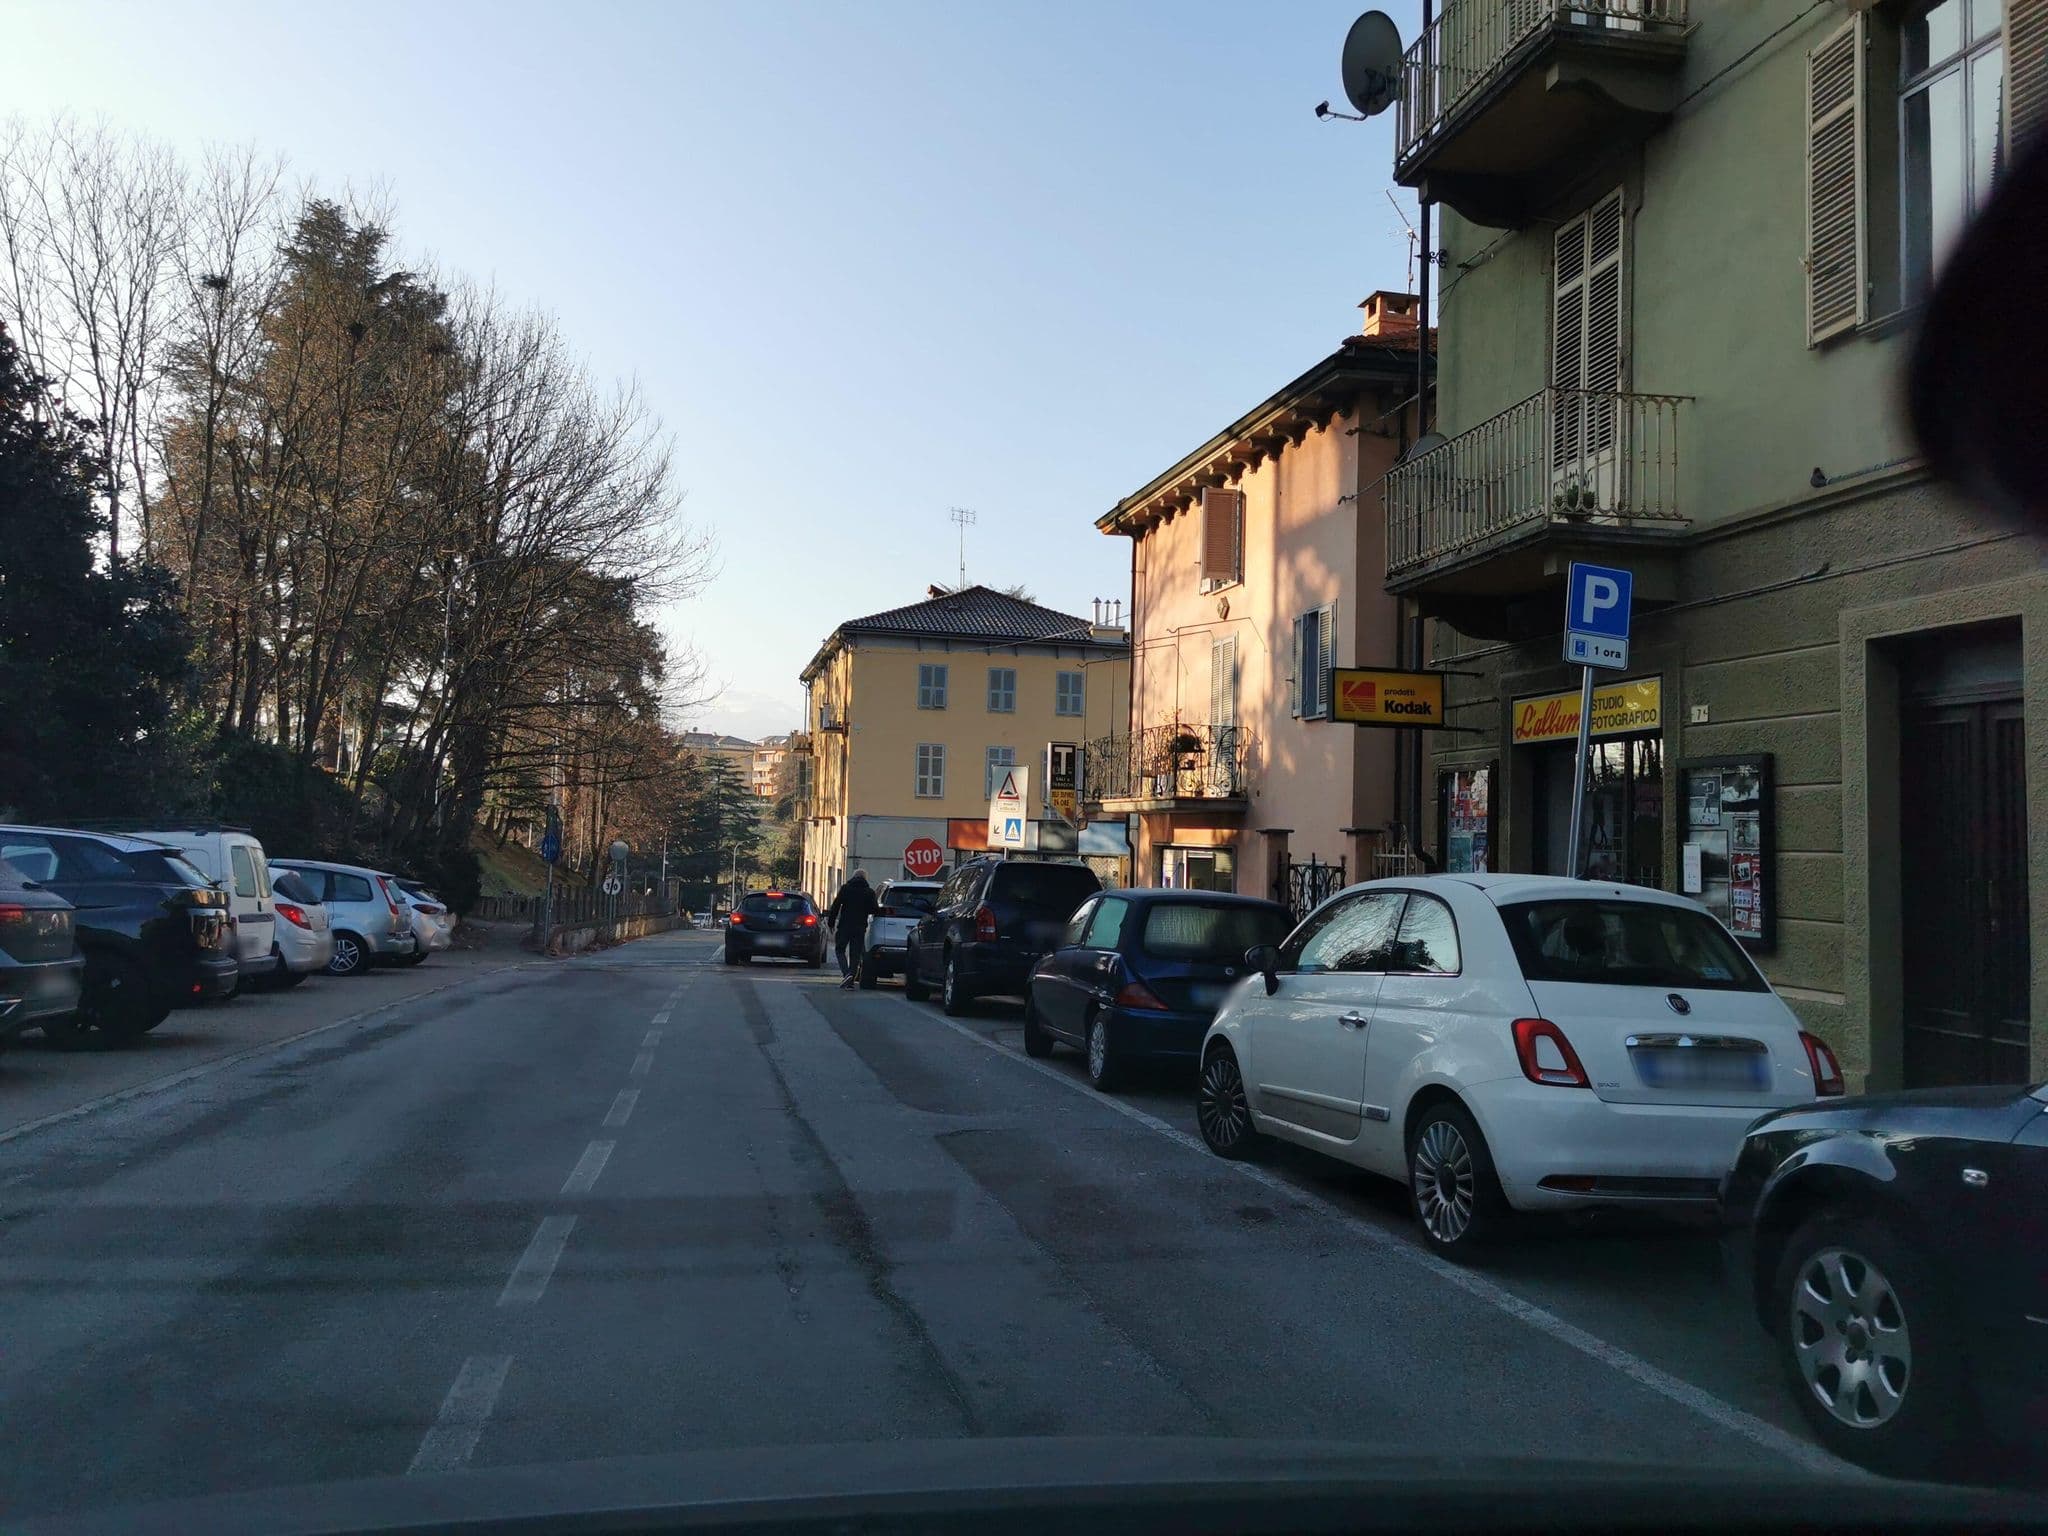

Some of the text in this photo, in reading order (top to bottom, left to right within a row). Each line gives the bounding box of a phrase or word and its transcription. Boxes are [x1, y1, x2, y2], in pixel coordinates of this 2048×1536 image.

[1583, 574, 1619, 624] P
[1594, 646, 1621, 659] 1 ora
[1384, 688, 1416, 697] prodotti
[1384, 700, 1432, 715] Kodak
[1591, 695, 1625, 711] STUDIO
[1591, 708, 1657, 730] FOTOGRAFICO
[1054, 747, 1073, 775] T
[907, 849, 941, 865] STOP
